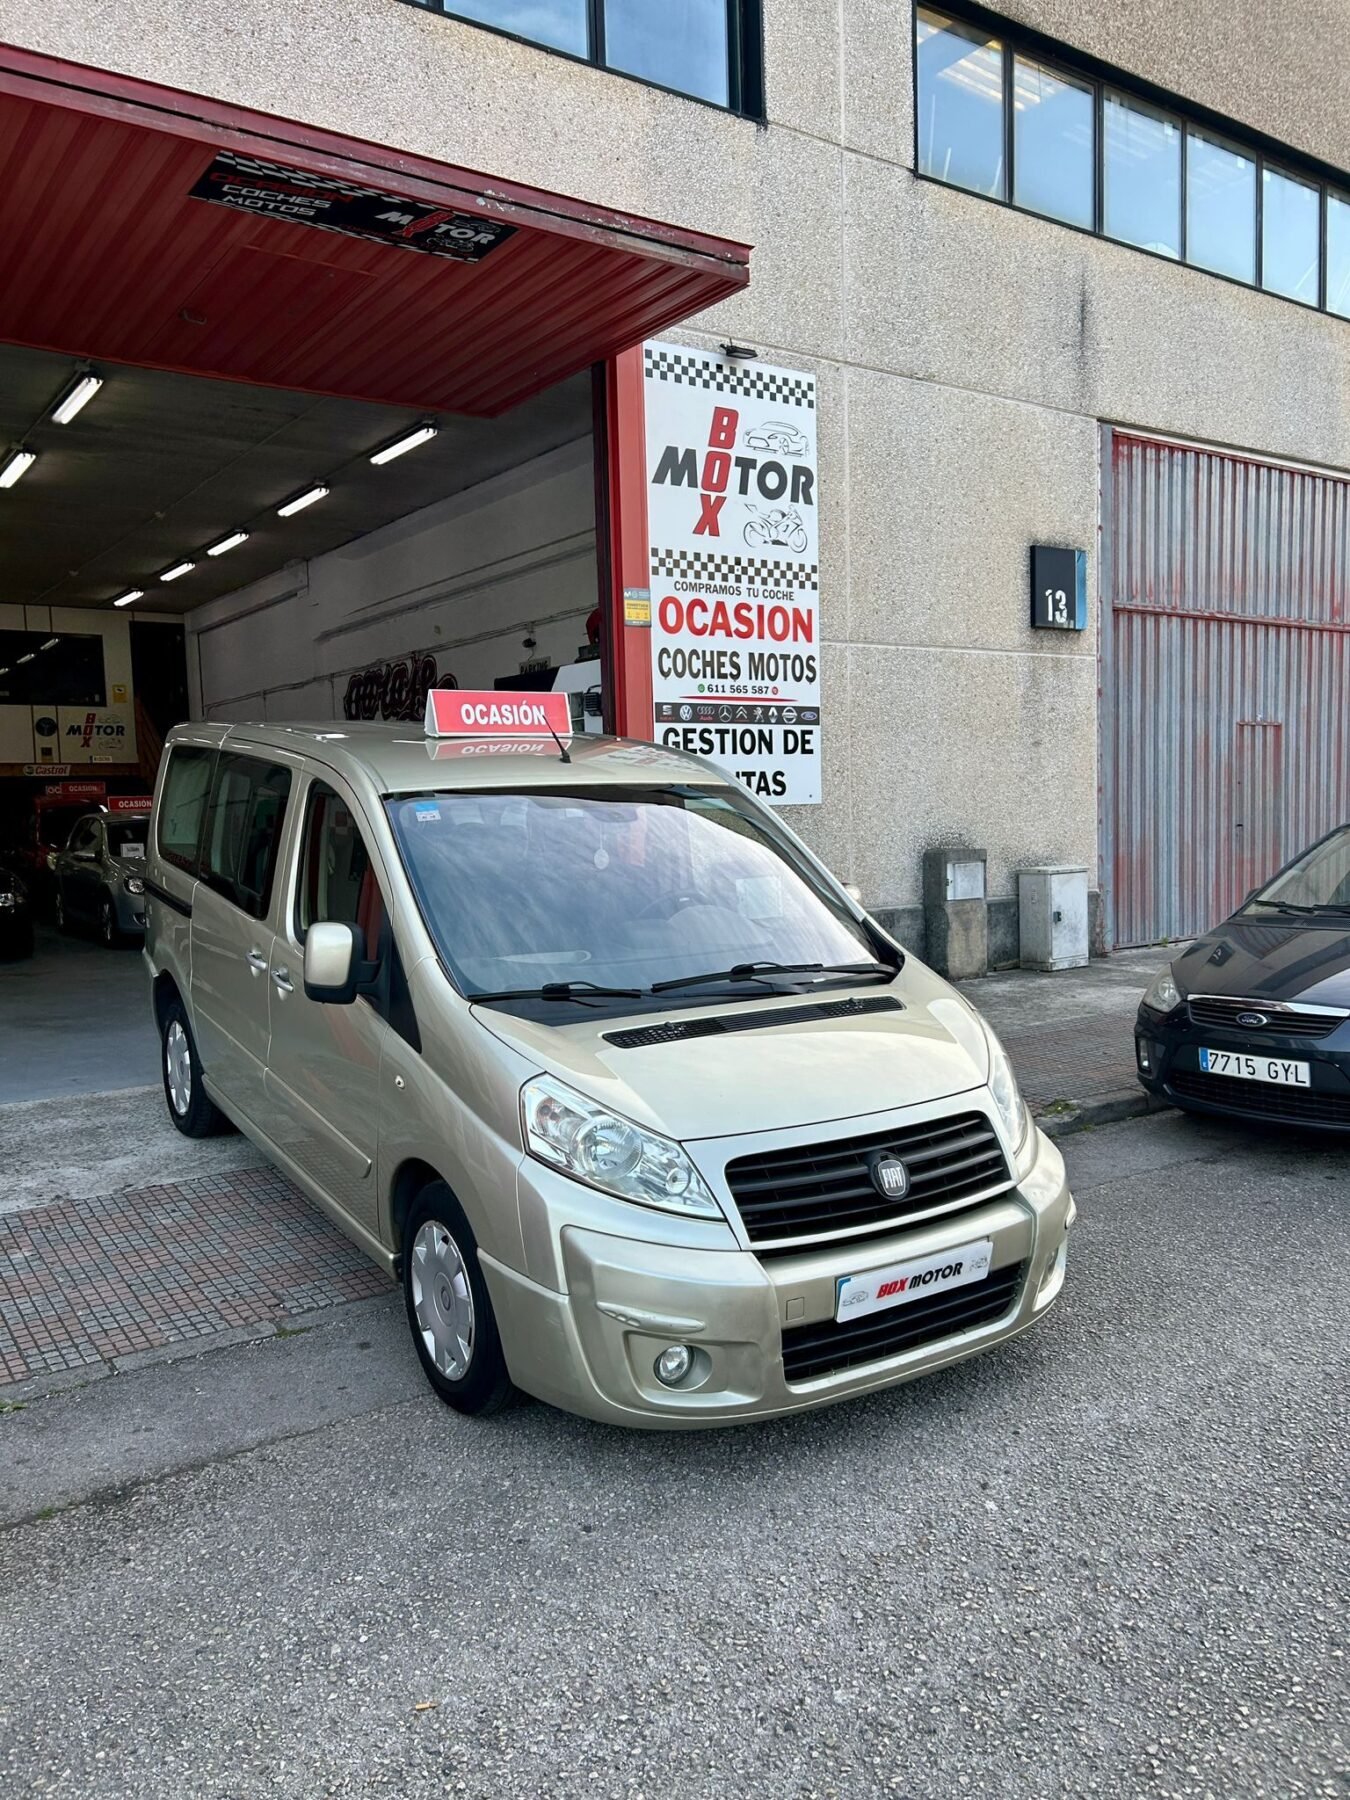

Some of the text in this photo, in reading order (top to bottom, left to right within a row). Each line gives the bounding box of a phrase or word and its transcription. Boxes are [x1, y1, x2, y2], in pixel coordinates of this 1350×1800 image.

[221, 184, 332, 209] COCHES
[222, 194, 316, 217] MOTOS
[692, 406, 739, 537] BOX
[674, 580, 794, 601] COMPRAMOS TU COCHE
[658, 595, 813, 643] OCASION
[1045, 589, 1068, 623] 13
[658, 647, 817, 684] COCHES MOTOS
[707, 684, 770, 696] 611 565 587
[460, 700, 548, 726] OCASIÓN
[80, 713, 96, 748] BOX
[662, 727, 814, 755] GESTION DE
[35, 765, 68, 775] Castrol
[1209, 1052, 1307, 1084] 7715 GYL
[881, 1165, 905, 1190] FIAT
[876, 1261, 963, 1300] BOX MOTOR
